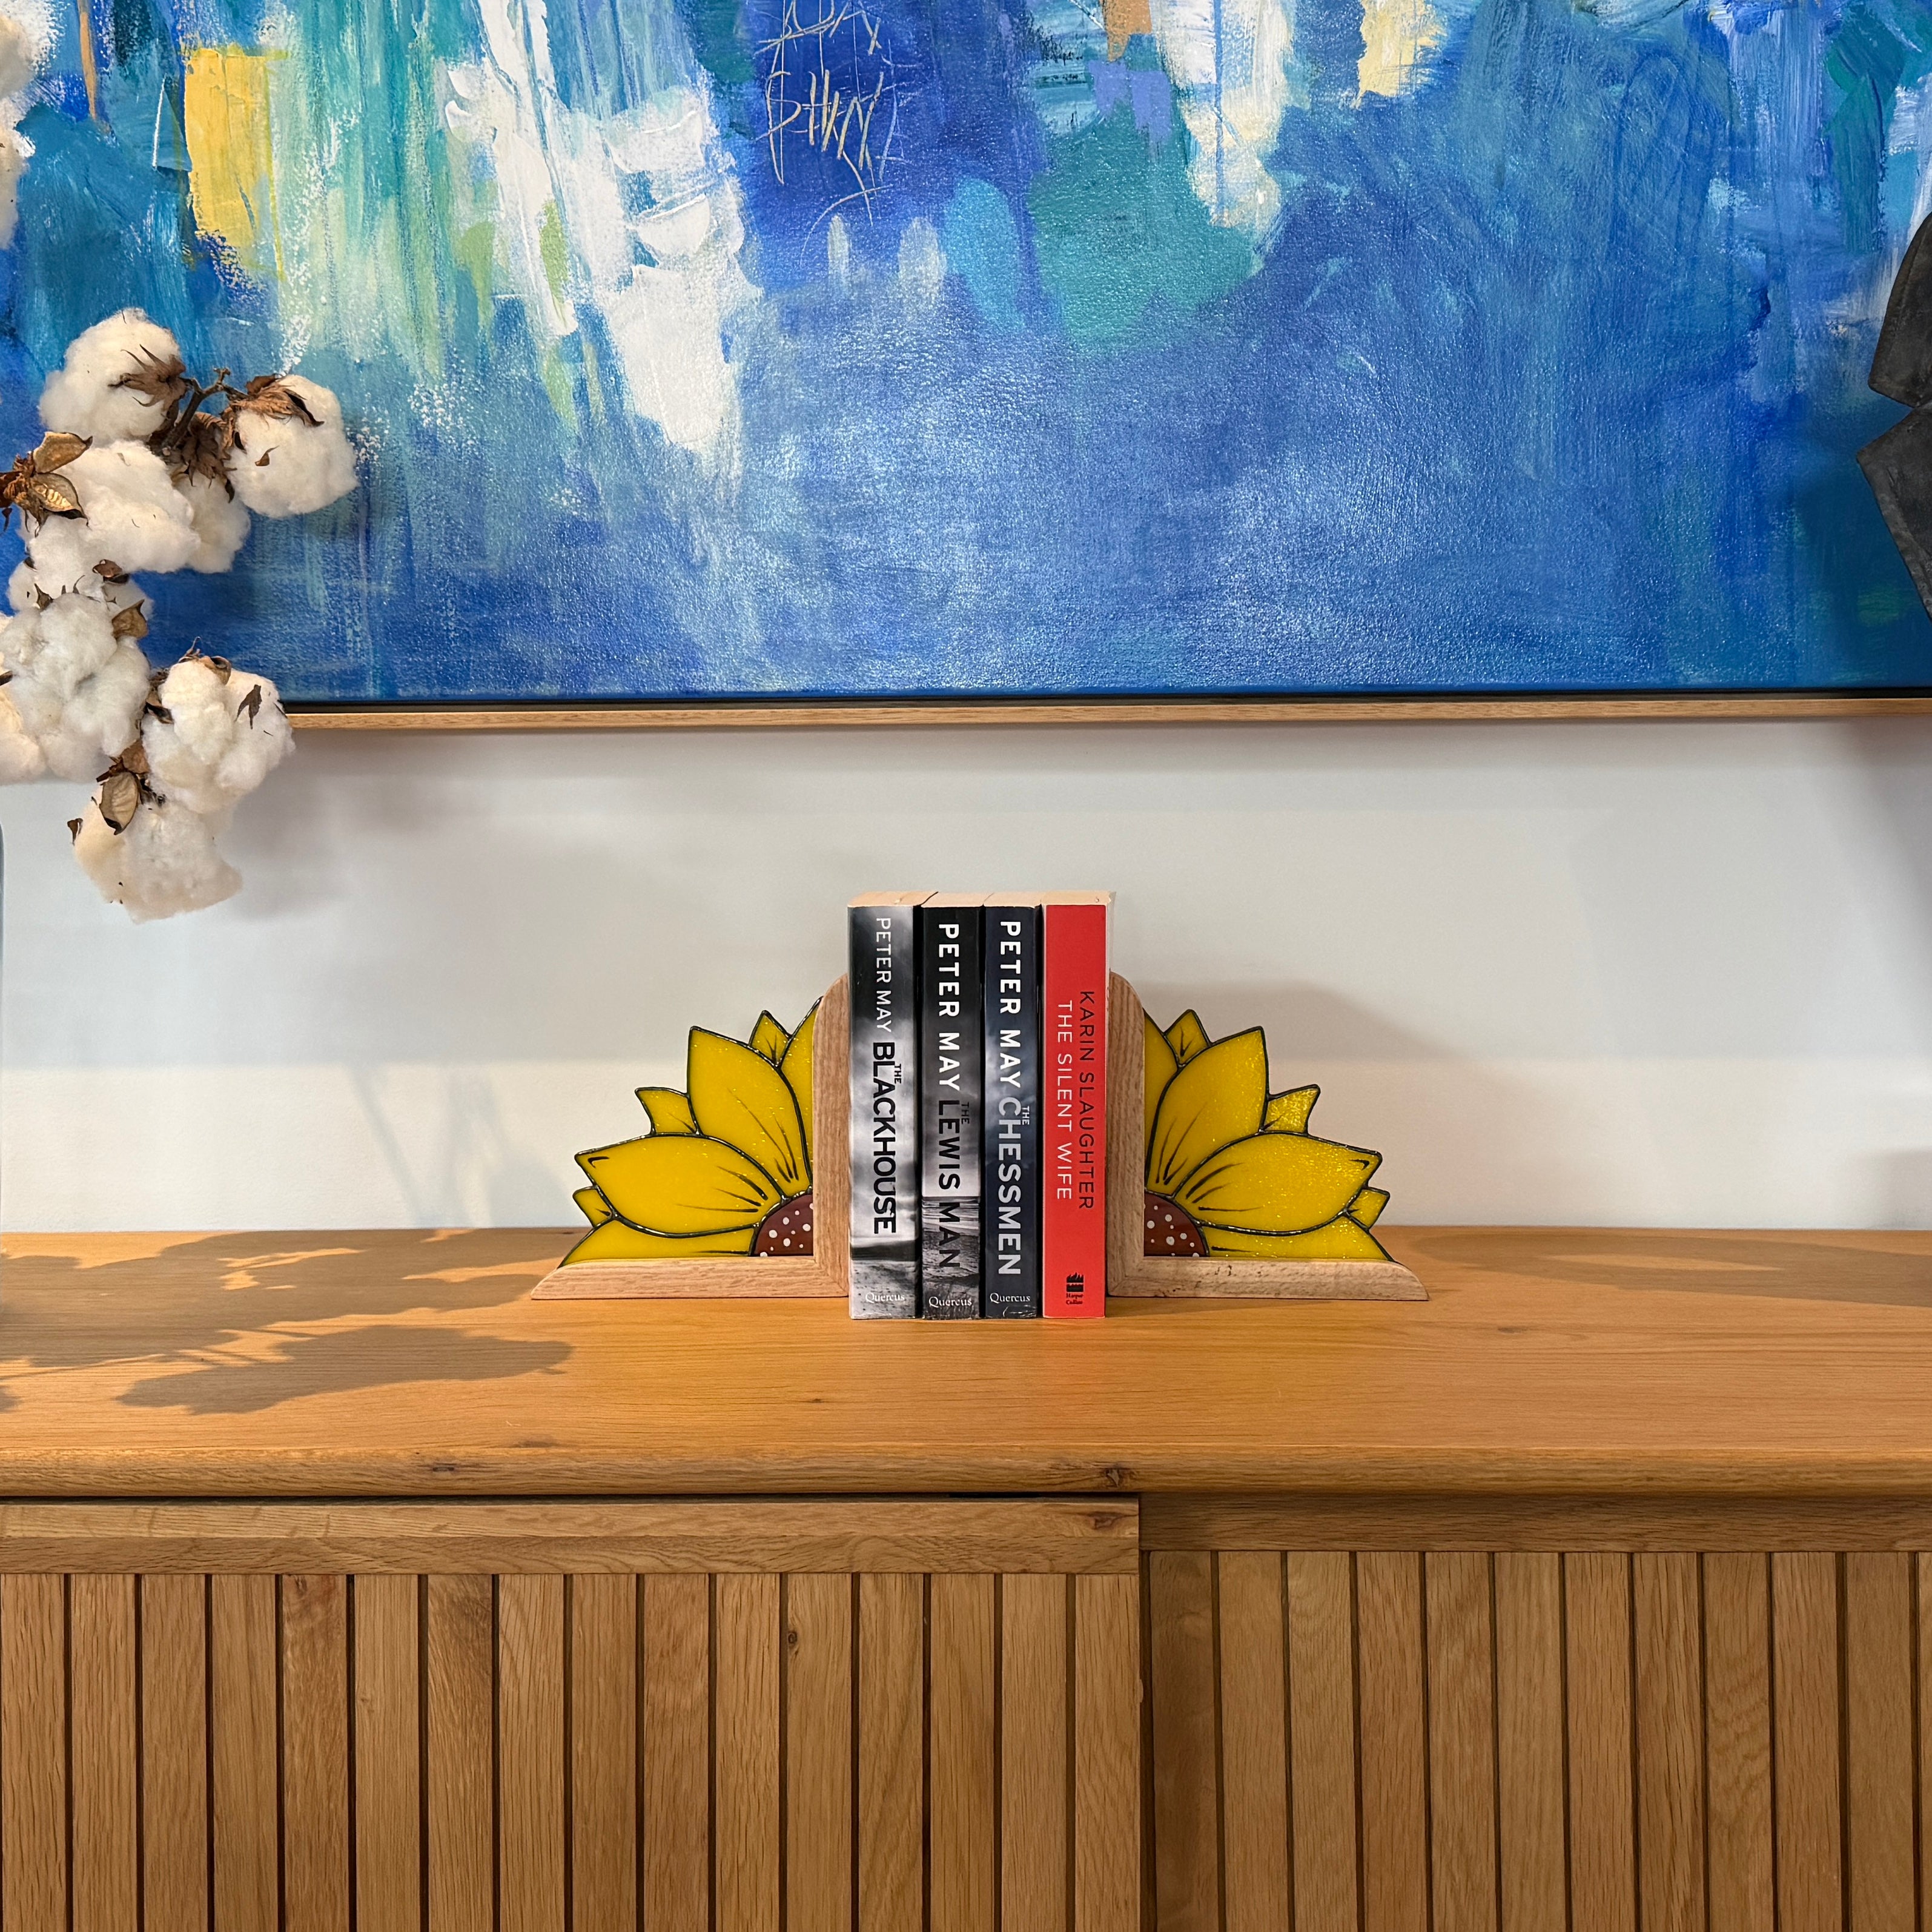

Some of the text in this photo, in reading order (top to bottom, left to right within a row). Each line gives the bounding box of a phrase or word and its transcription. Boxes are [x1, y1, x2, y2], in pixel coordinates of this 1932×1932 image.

[876, 917, 892, 1033] PETER MAY
[938, 923, 960, 1091] PETER MAY
[999, 921, 1021, 1088] PETER MAY
[872, 1041, 896, 1234] BLACKHOUSE
[893, 1063, 902, 1084] THE
[961, 1101, 970, 1124] THE
[1021, 1105, 1030, 1125] THE
[1056, 1000, 1073, 1200] THE SILENT WIFE
[1079, 991, 1096, 1210] KARIN SLAUGHTER
[938, 1100, 961, 1268] LEWIS MAN
[997, 1096, 1021, 1275] CHESSMEN
[864, 1291, 905, 1303] Quercus
[928, 1296, 973, 1308] Quercus
[990, 1292, 1031, 1303] Quercus
